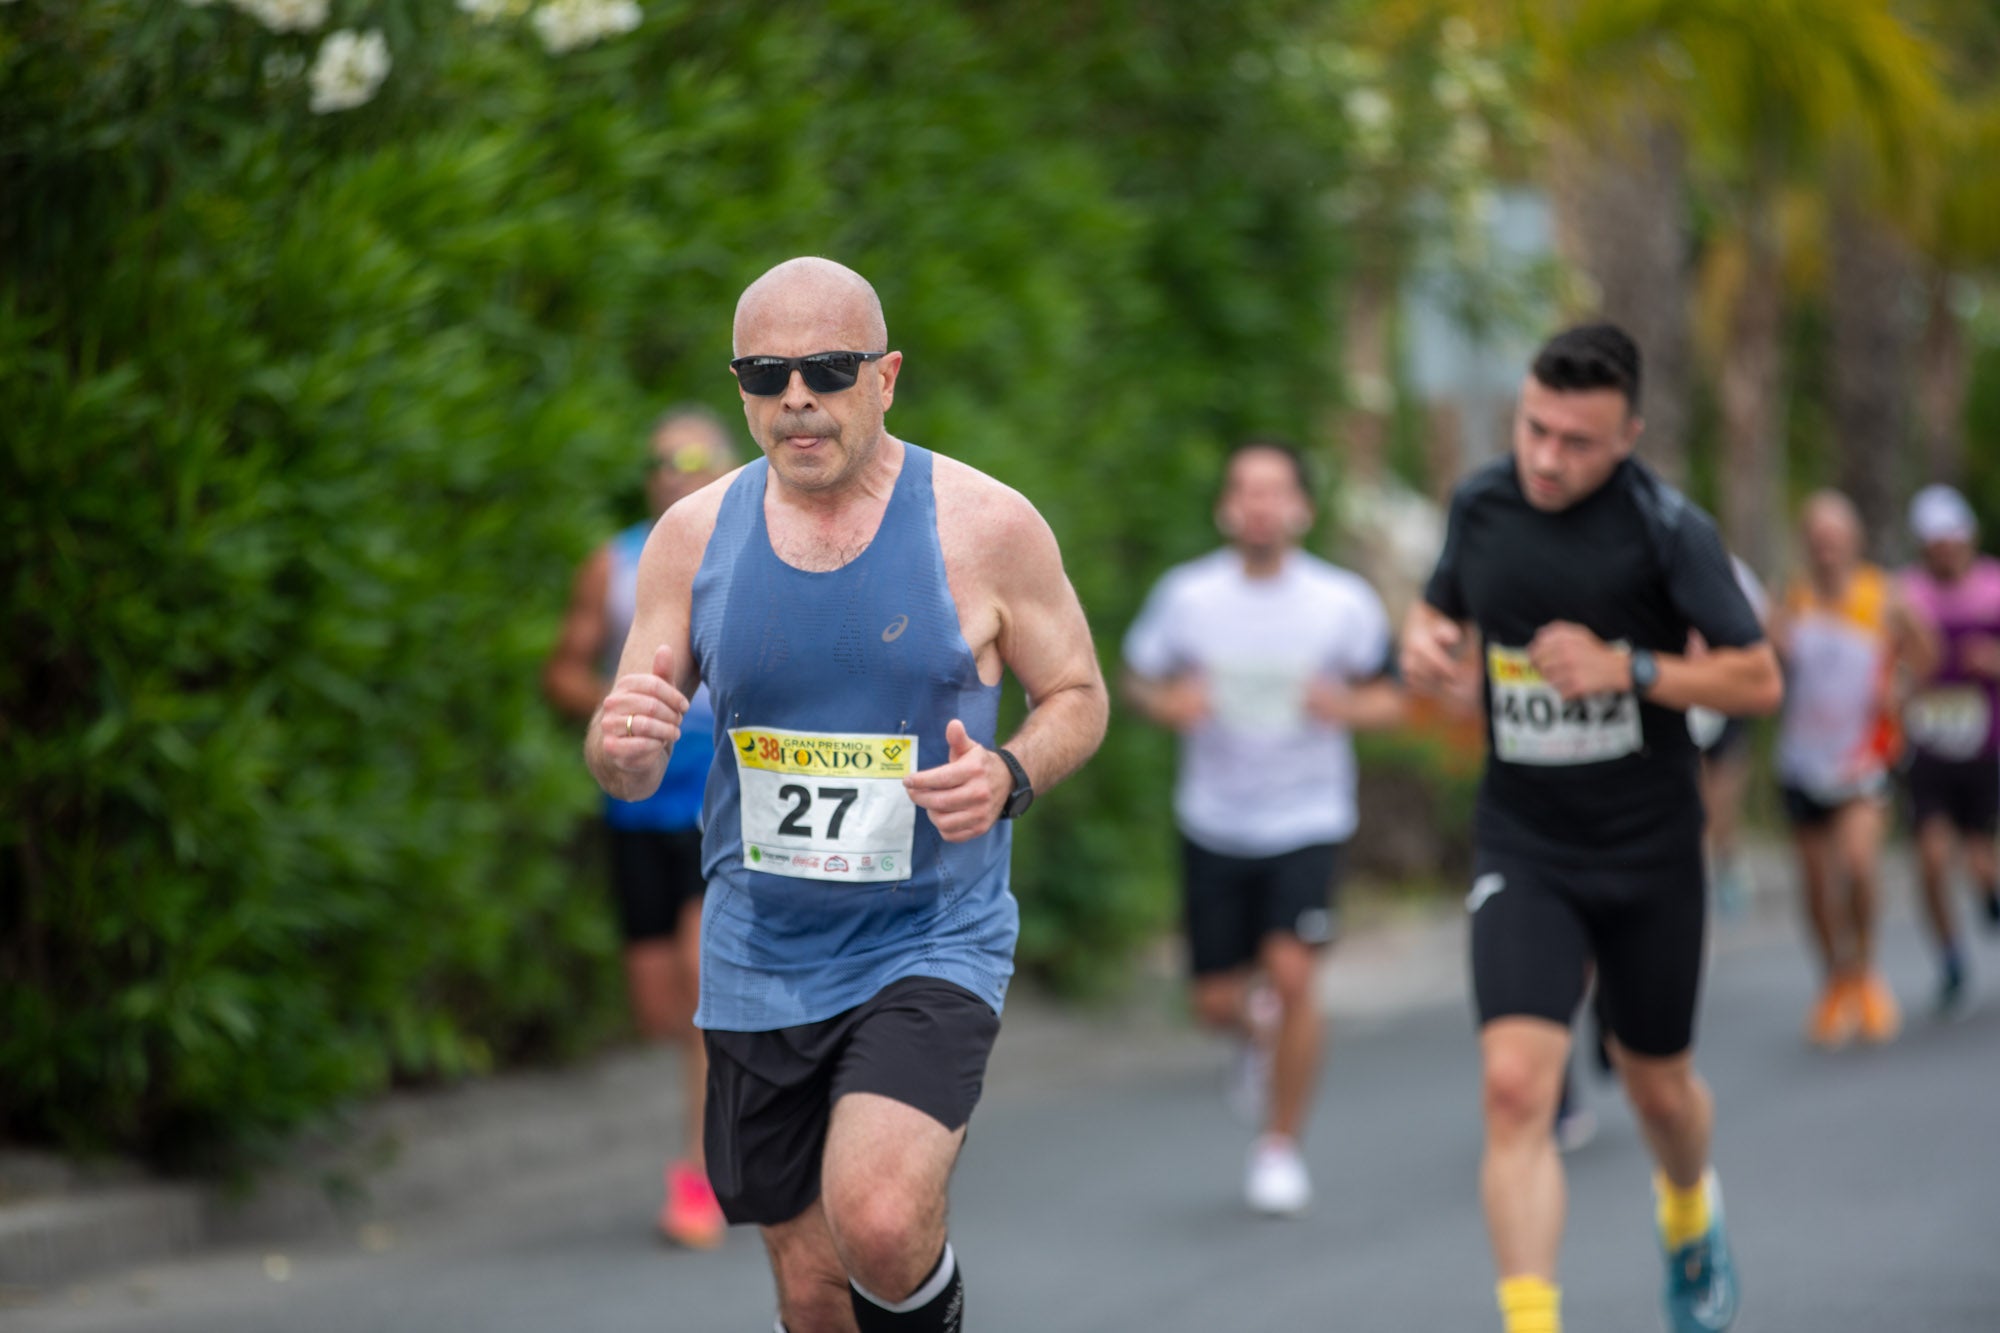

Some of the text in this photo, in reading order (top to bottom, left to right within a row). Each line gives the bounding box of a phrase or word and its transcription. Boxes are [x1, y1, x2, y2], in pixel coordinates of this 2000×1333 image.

[757, 736, 780, 762] 38
[783, 738, 816, 750] GRAN
[818, 740, 864, 751] PREMIO
[780, 747, 873, 769] FONDO
[777, 784, 859, 840] 27
